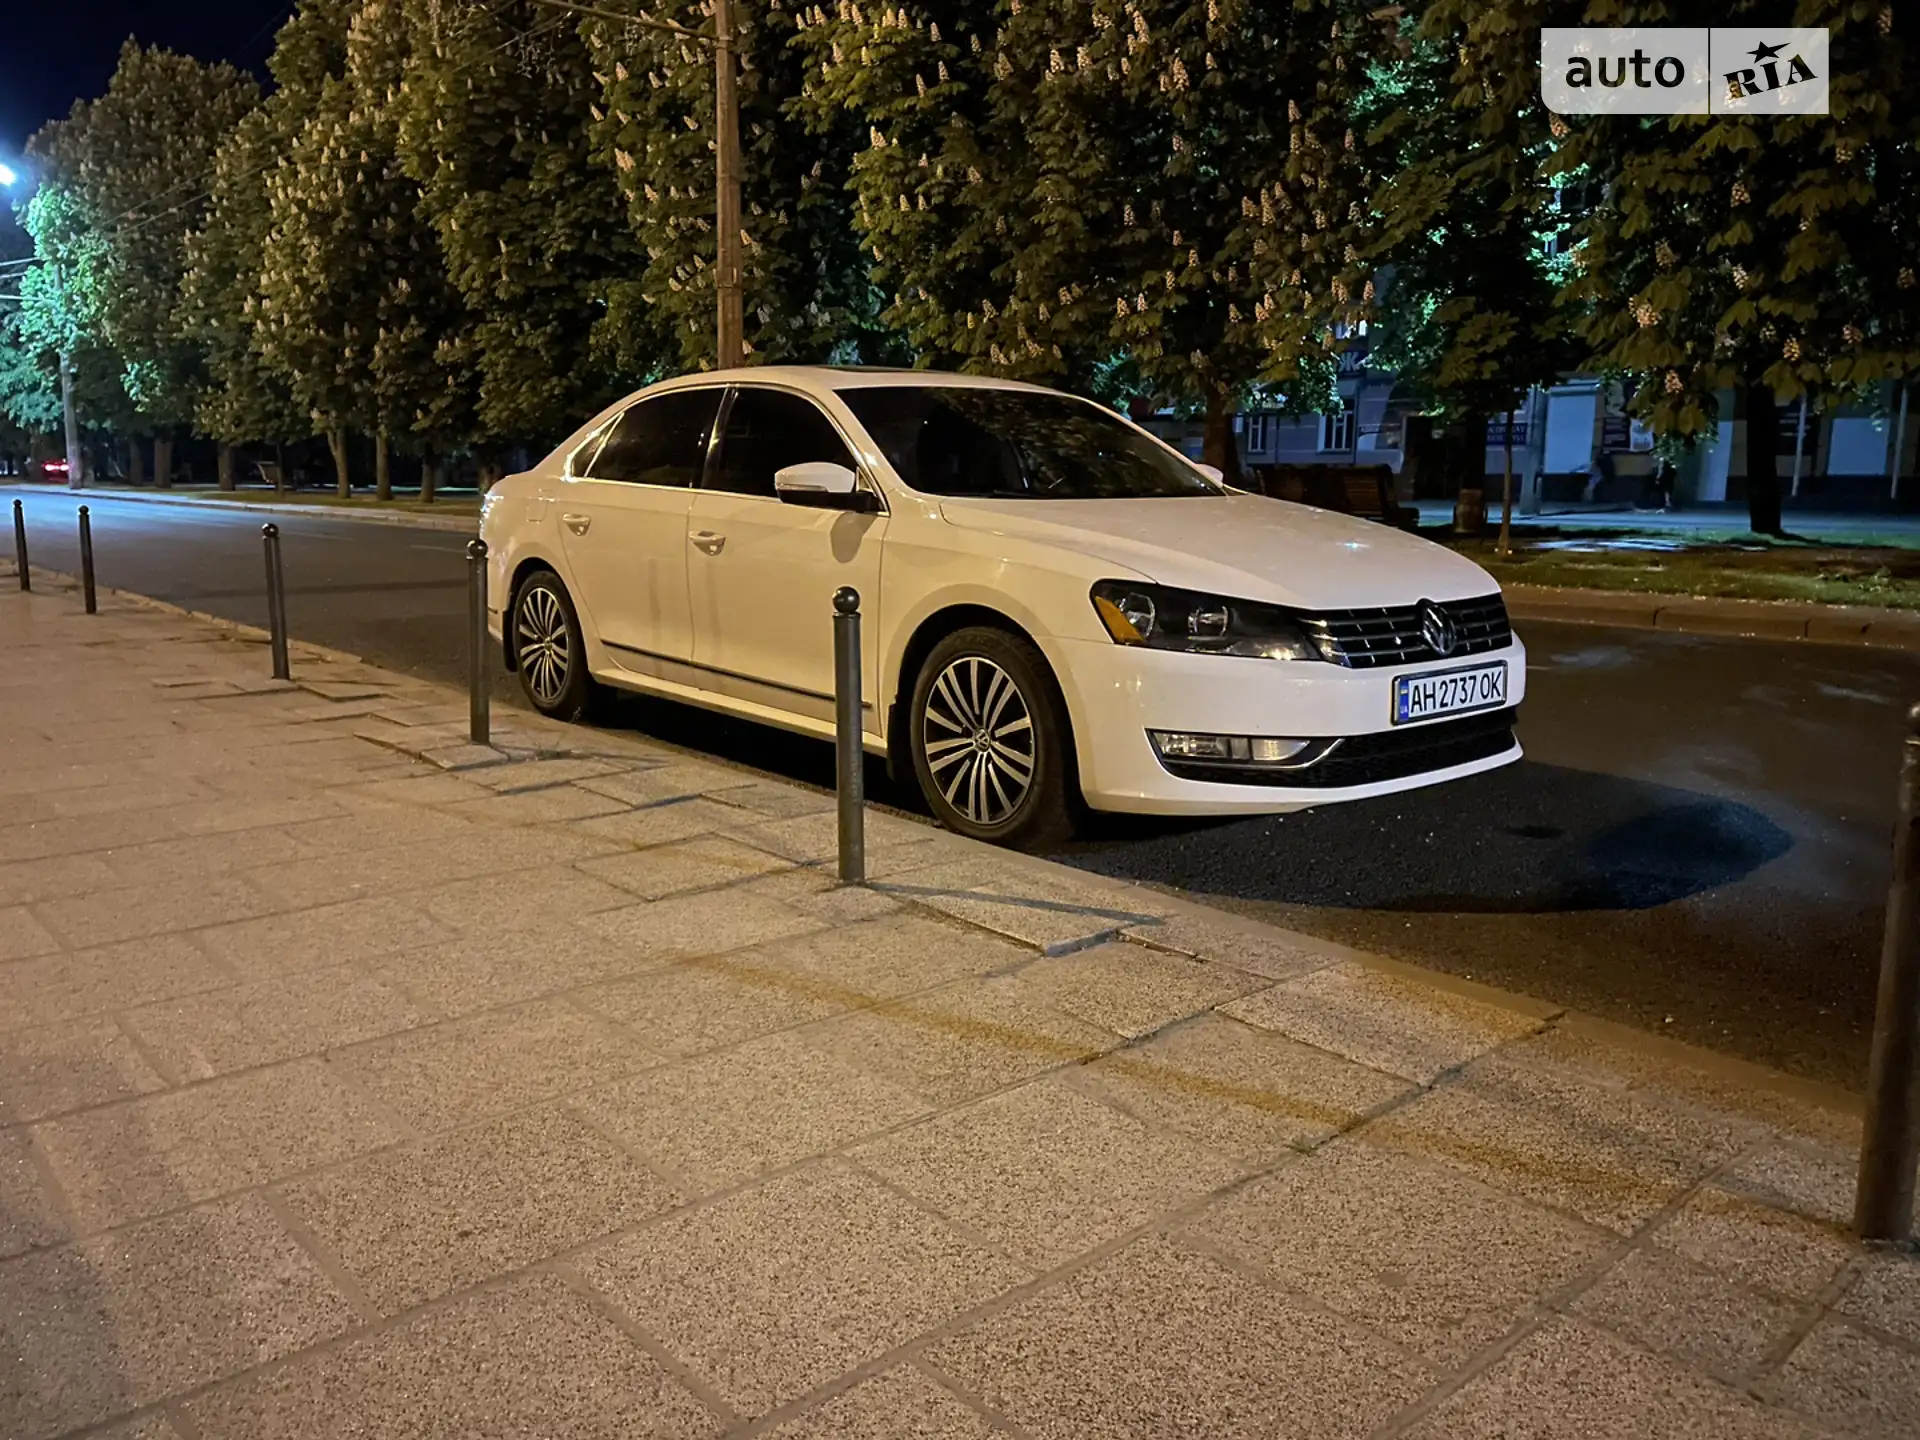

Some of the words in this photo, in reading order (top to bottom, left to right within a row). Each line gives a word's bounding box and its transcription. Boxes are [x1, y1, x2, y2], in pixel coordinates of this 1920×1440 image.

[1411, 682, 1436, 713] AH
[1439, 675, 1477, 709] 2737
[1480, 671, 1502, 700] OK
